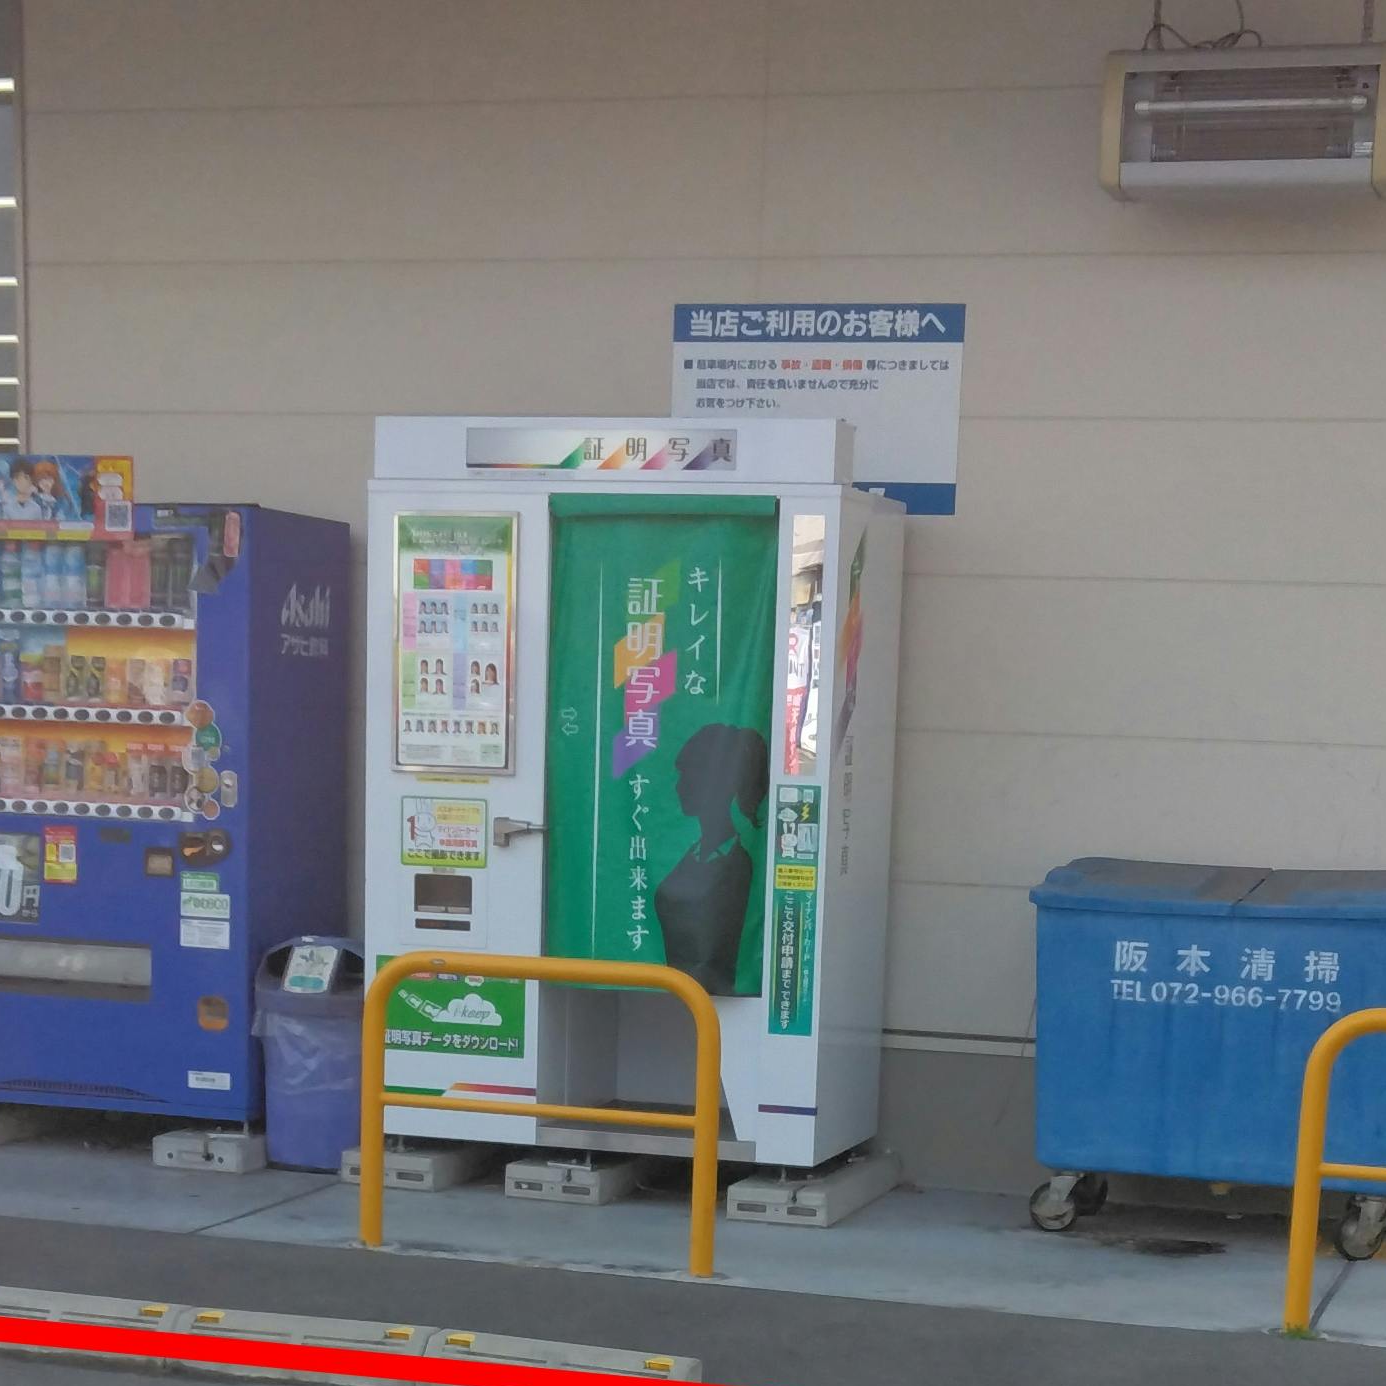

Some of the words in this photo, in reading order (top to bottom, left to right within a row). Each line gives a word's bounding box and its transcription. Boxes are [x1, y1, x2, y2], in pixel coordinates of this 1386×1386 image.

[690, 309, 946, 338] 当店ご利用のお客様へ
[583, 437, 732, 462] 証明写真
[281, 583, 330, 628] Asahi
[683, 566, 709, 695] キレイな
[625, 577, 664, 748] 証明写真
[627, 775, 649, 951] すぐ出来ます
[1113, 940, 1341, 985] 阪本清掃
